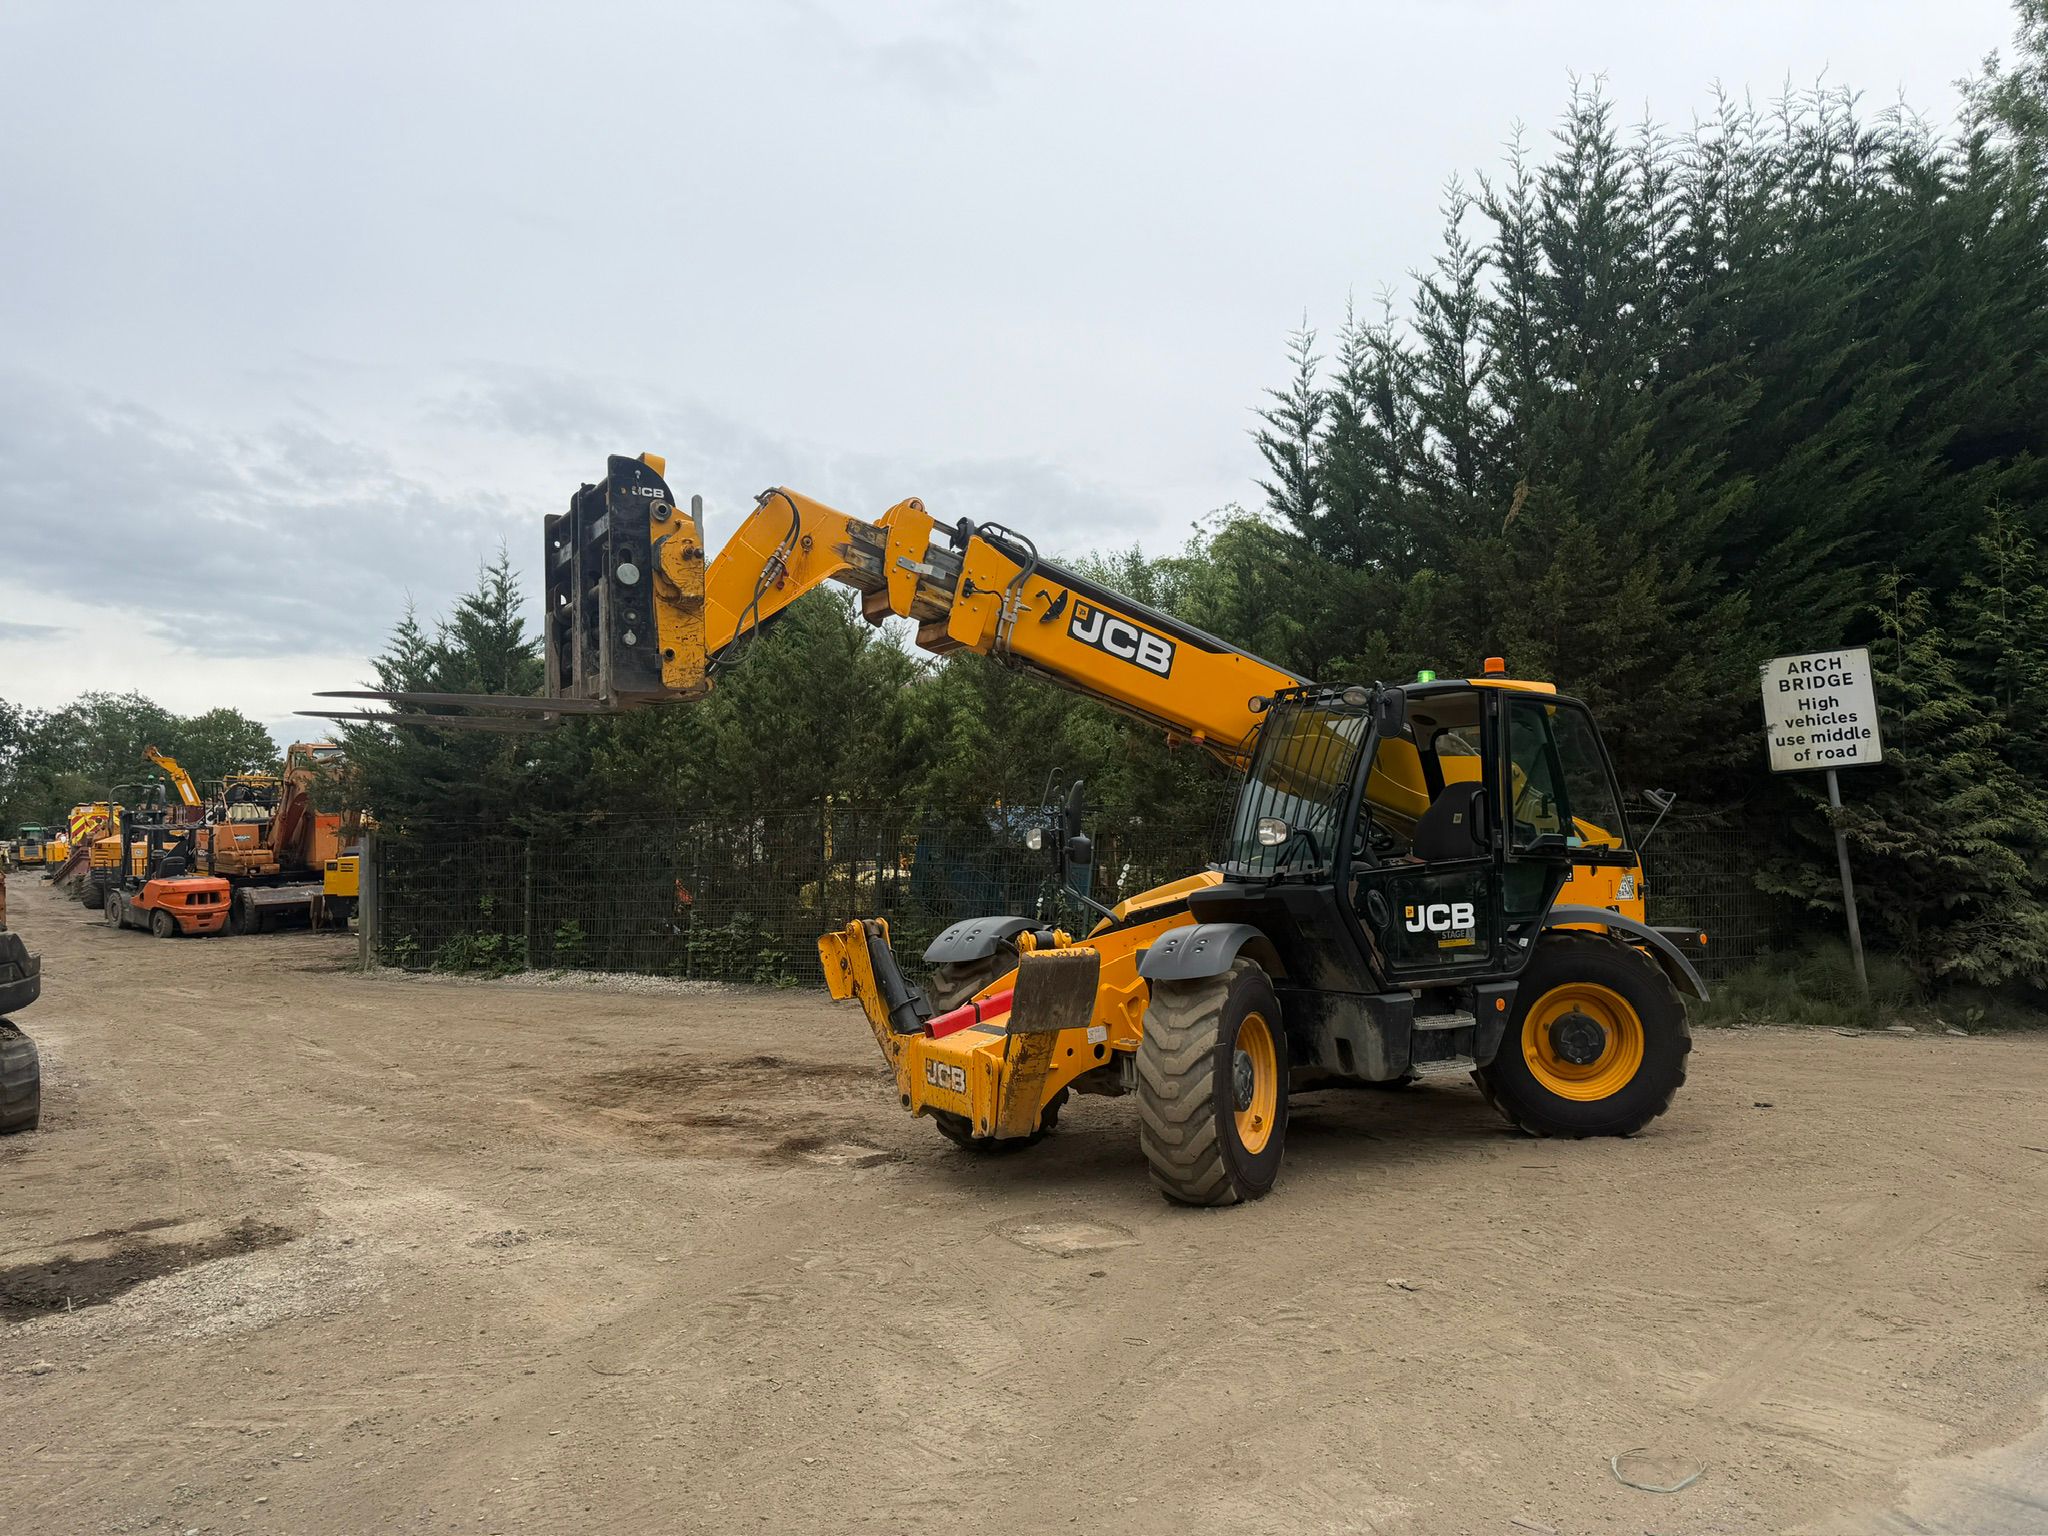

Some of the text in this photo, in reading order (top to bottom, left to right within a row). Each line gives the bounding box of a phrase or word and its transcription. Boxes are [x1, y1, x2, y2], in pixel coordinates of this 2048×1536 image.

[1072, 610, 1172, 674] JCB
[1787, 657, 1842, 675] ARCH
[1779, 672, 1854, 693] BRIDGE
[1798, 696, 1840, 711] High
[1785, 712, 1858, 728] vehicles
[1776, 726, 1872, 747] use middle
[1794, 744, 1858, 762] of road
[1405, 902, 1475, 933] JCB
[1441, 929, 1465, 940] STAGE
[926, 1060, 967, 1094] JCB
